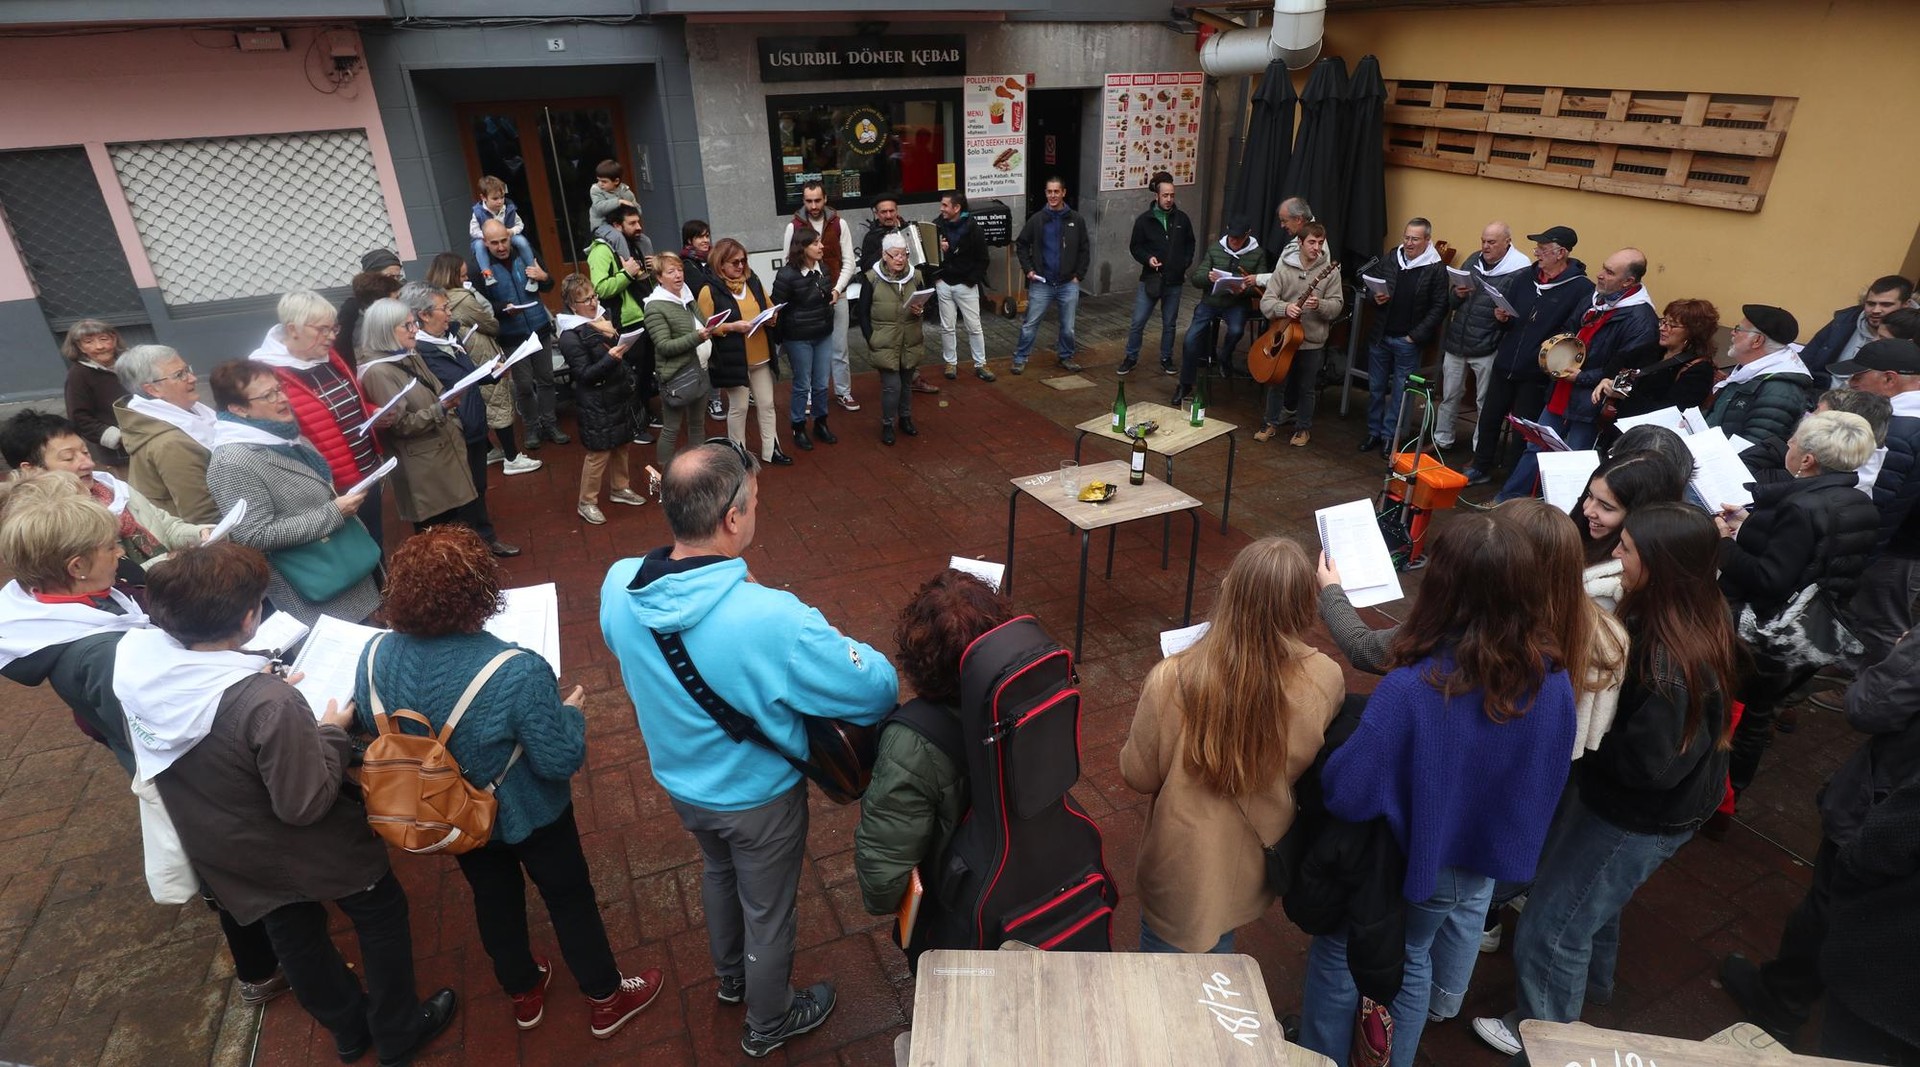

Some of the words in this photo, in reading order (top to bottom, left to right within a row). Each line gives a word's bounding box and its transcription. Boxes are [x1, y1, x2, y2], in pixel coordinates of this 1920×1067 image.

[554, 39, 560, 50] 5
[769, 50, 841, 67] USURBIL
[848, 48, 905, 65] DÖNER
[911, 49, 960, 66] KEBAB
[967, 139, 984, 147] PLATO
[986, 138, 1004, 146] SEEKH
[1005, 137, 1023, 145] KEBAB
[1198, 972, 1260, 1046] 18/70
